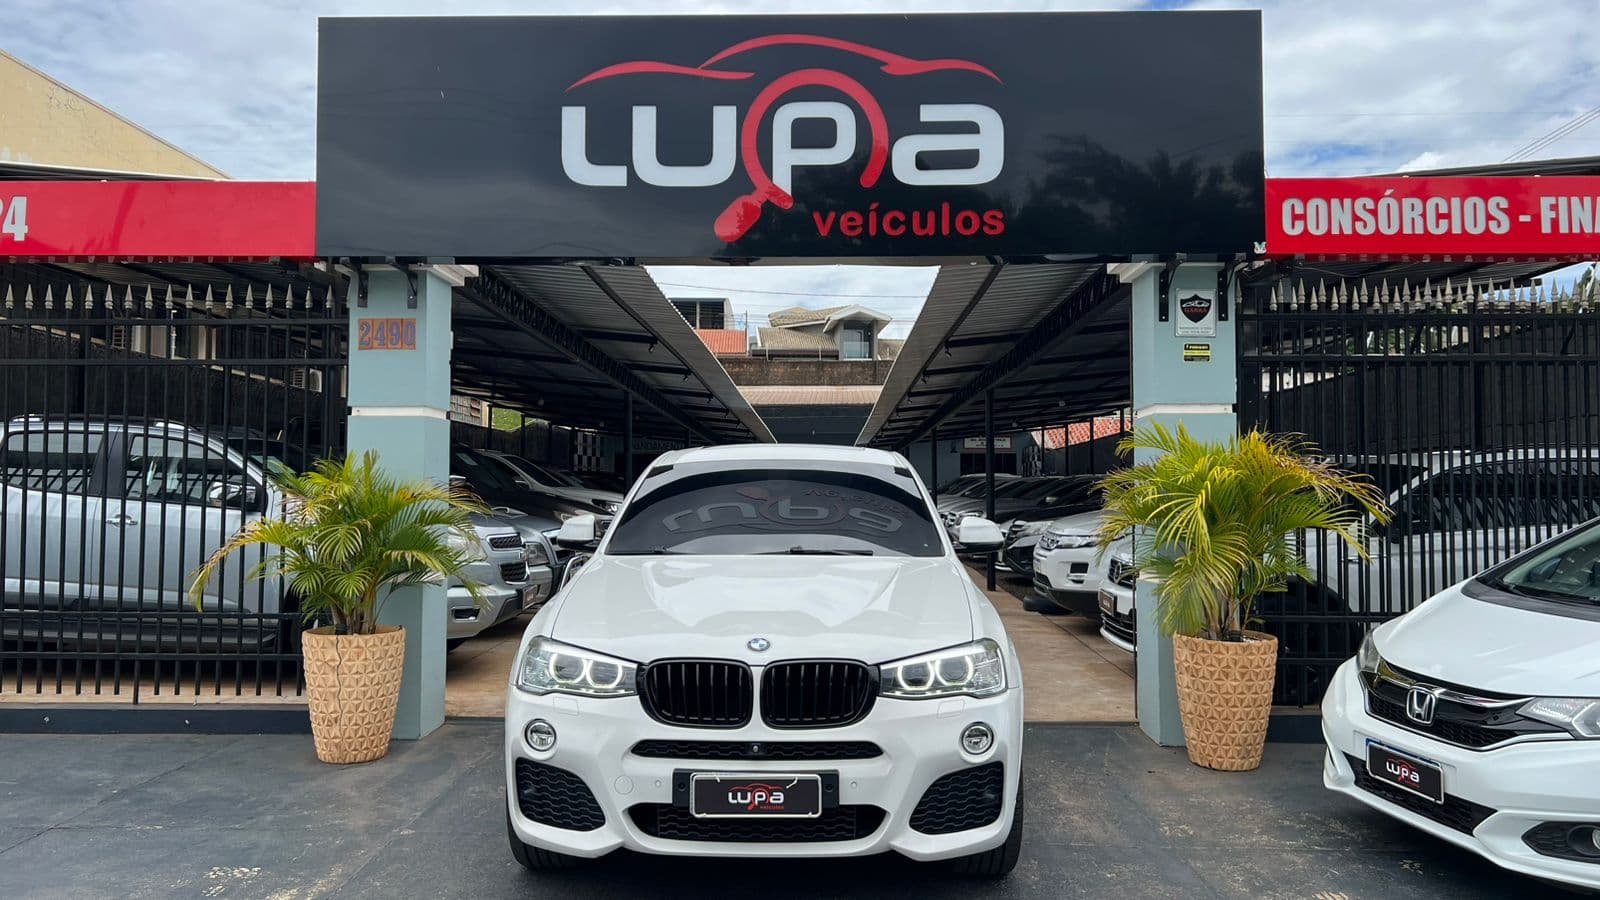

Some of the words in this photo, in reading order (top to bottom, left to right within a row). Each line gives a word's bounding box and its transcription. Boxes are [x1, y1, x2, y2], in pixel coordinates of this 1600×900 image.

[0, 196, 29, 242] 4
[813, 202, 1006, 237] veículos
[1282, 189, 1511, 236] CONSÓRCIOS
[359, 320, 417, 347] 2490
